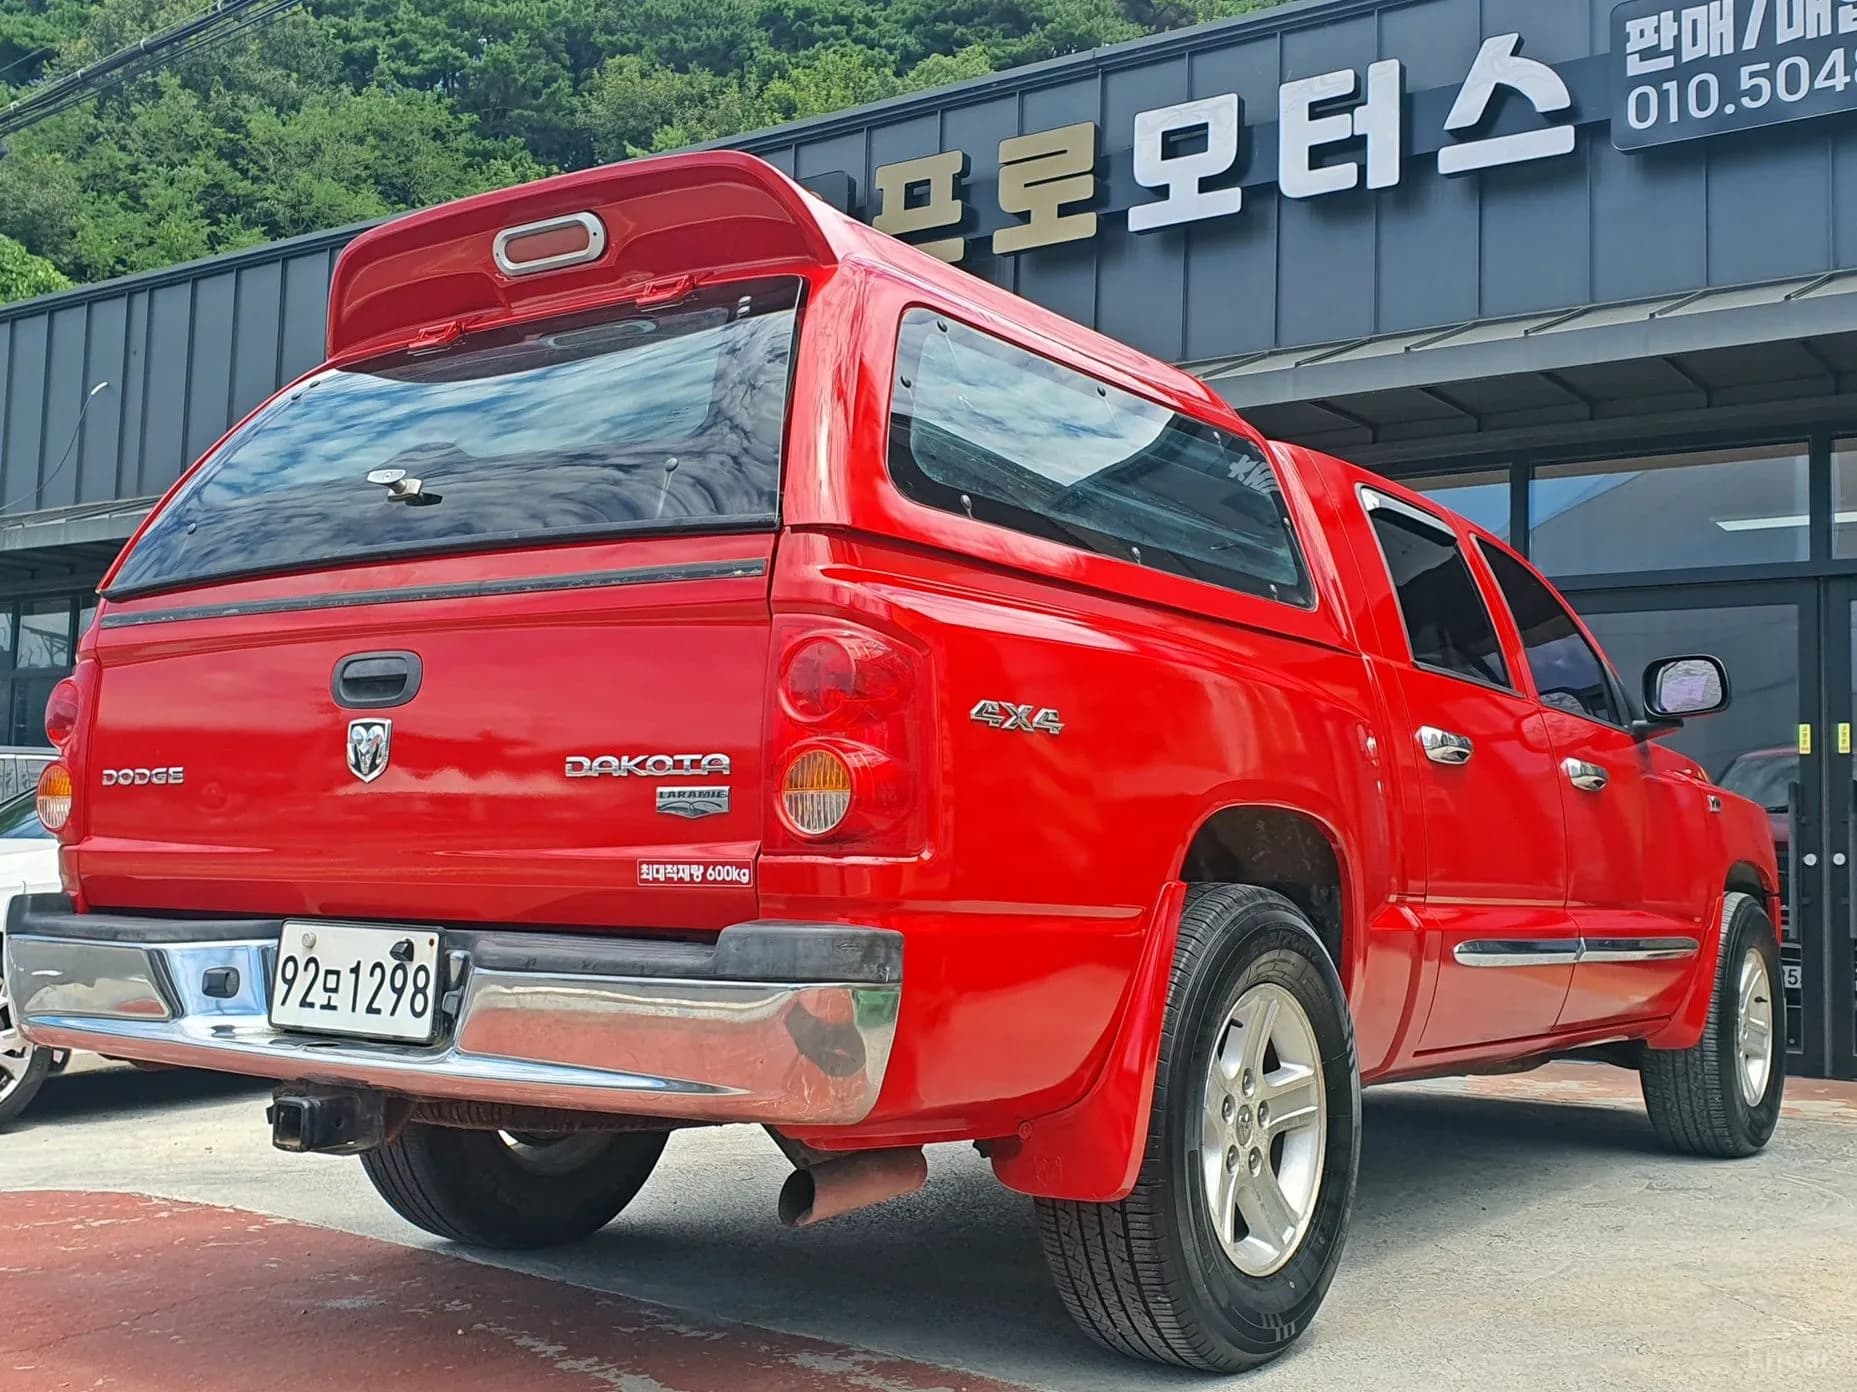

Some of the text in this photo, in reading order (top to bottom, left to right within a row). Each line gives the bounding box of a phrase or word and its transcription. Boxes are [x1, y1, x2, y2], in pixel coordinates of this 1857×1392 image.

[1627, 47, 1857, 130] 010.504
[565, 753, 731, 777] DAKOTA
[102, 767, 184, 786] DODGE
[658, 789, 728, 799] LARAMIE
[640, 863, 750, 884] 최대적재량 600kg
[280, 955, 431, 1019] 92모1298
